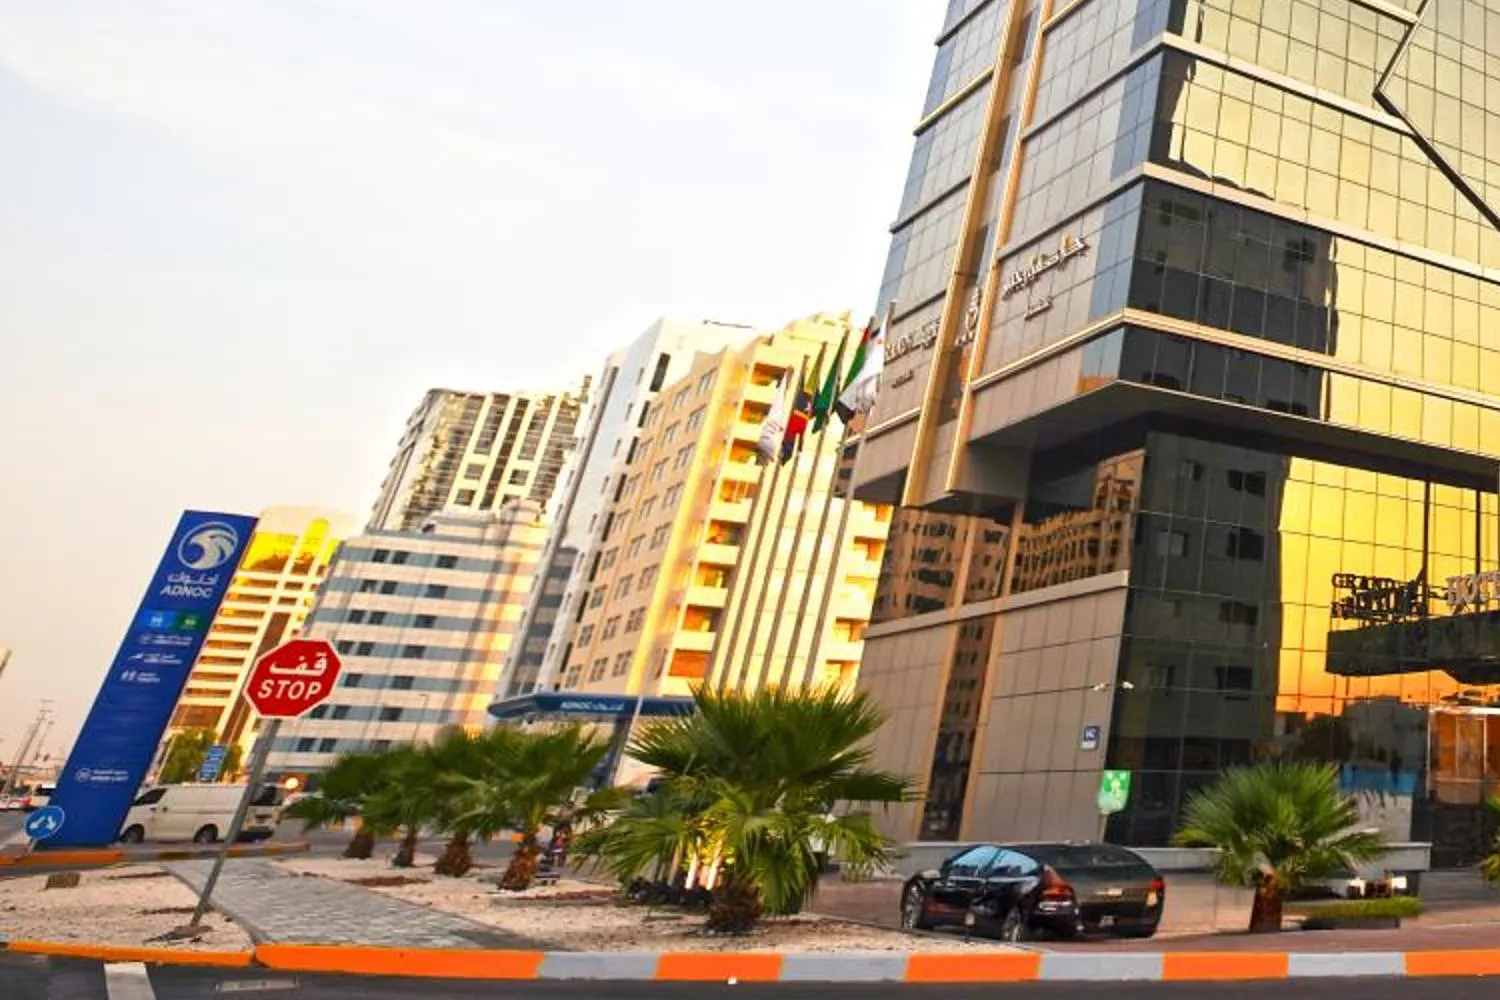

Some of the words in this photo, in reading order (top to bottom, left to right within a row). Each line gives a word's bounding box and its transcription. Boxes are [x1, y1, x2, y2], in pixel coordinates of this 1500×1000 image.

[160, 584, 213, 598] ADNOC
[269, 652, 327, 677] قف
[257, 679, 322, 700] STOP
